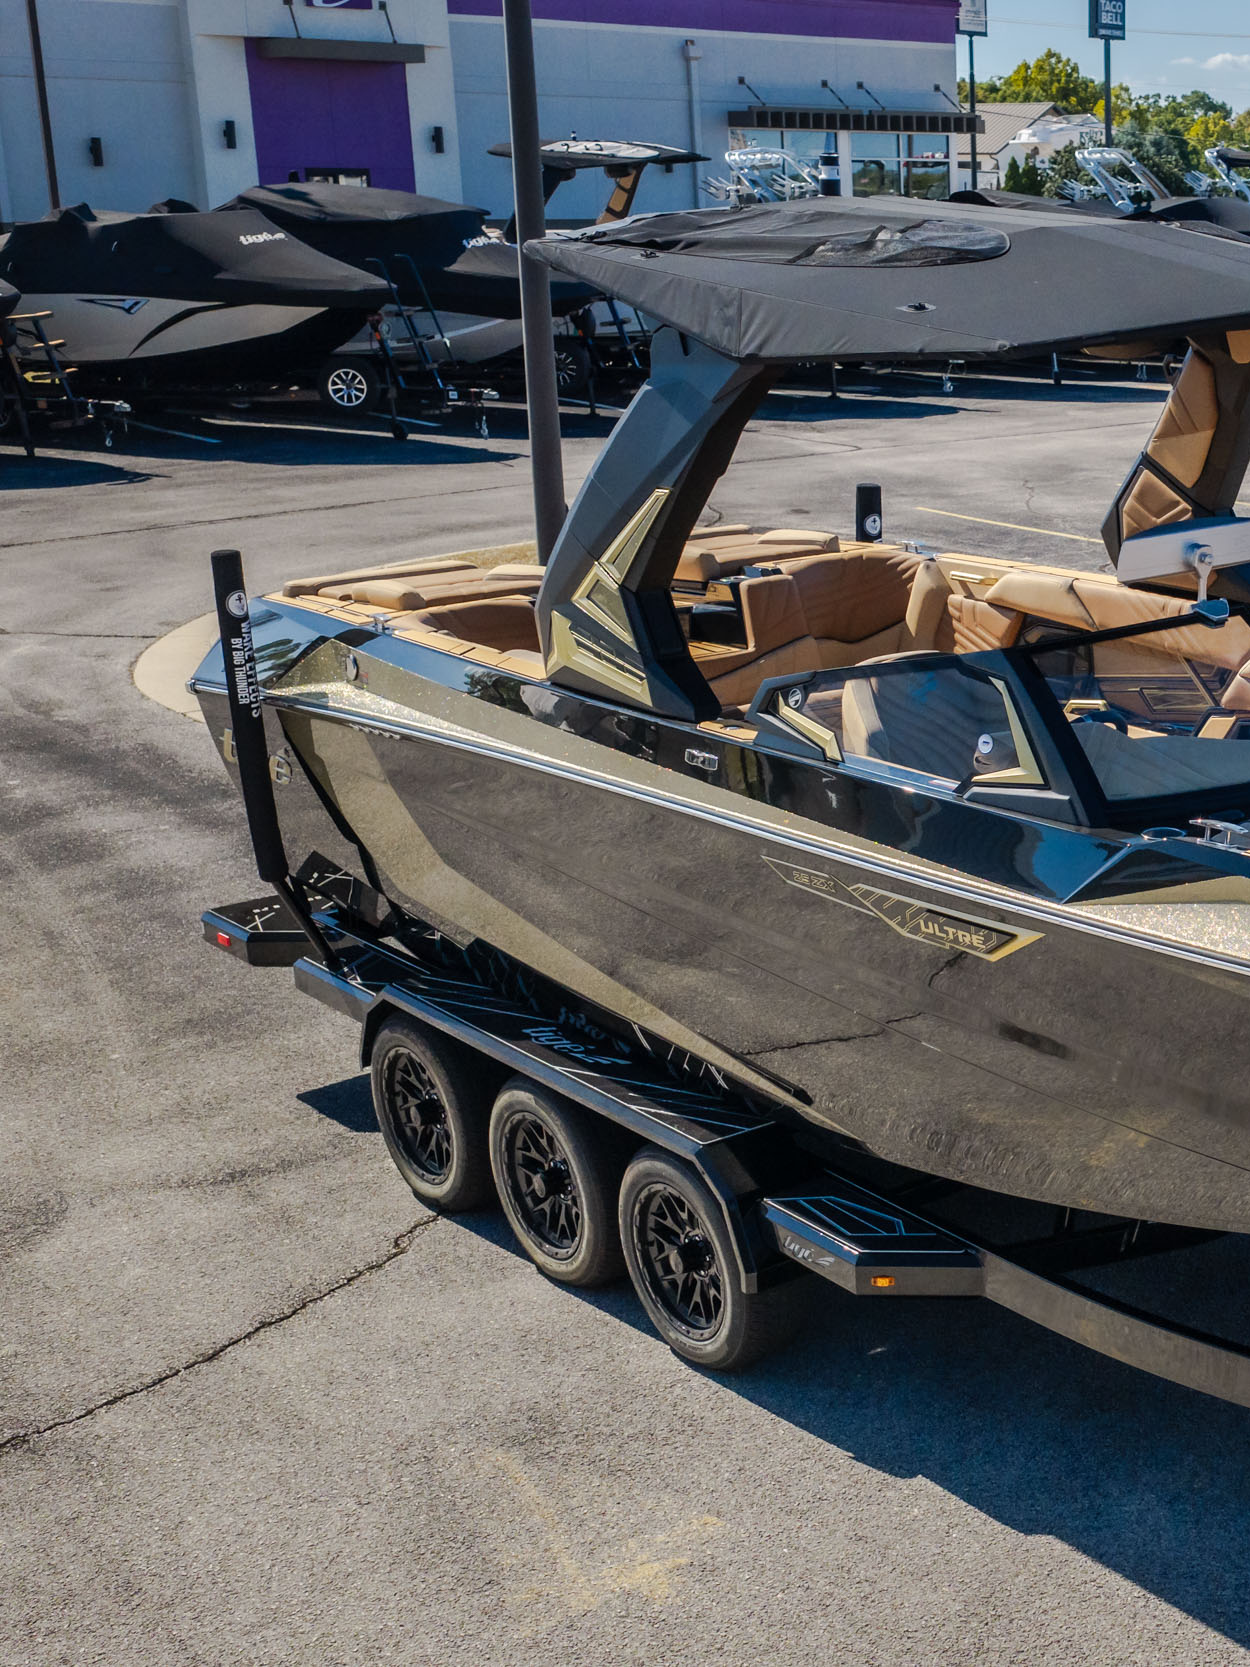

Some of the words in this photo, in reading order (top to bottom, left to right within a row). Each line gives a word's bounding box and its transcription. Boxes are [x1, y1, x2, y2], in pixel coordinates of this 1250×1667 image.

[1100, 0, 1123, 13] TACO
[1101, 11, 1122, 25] BELL
[230, 637, 244, 649] BY
[232, 650, 245, 665] BIG
[234, 665, 250, 705] THUNDER
